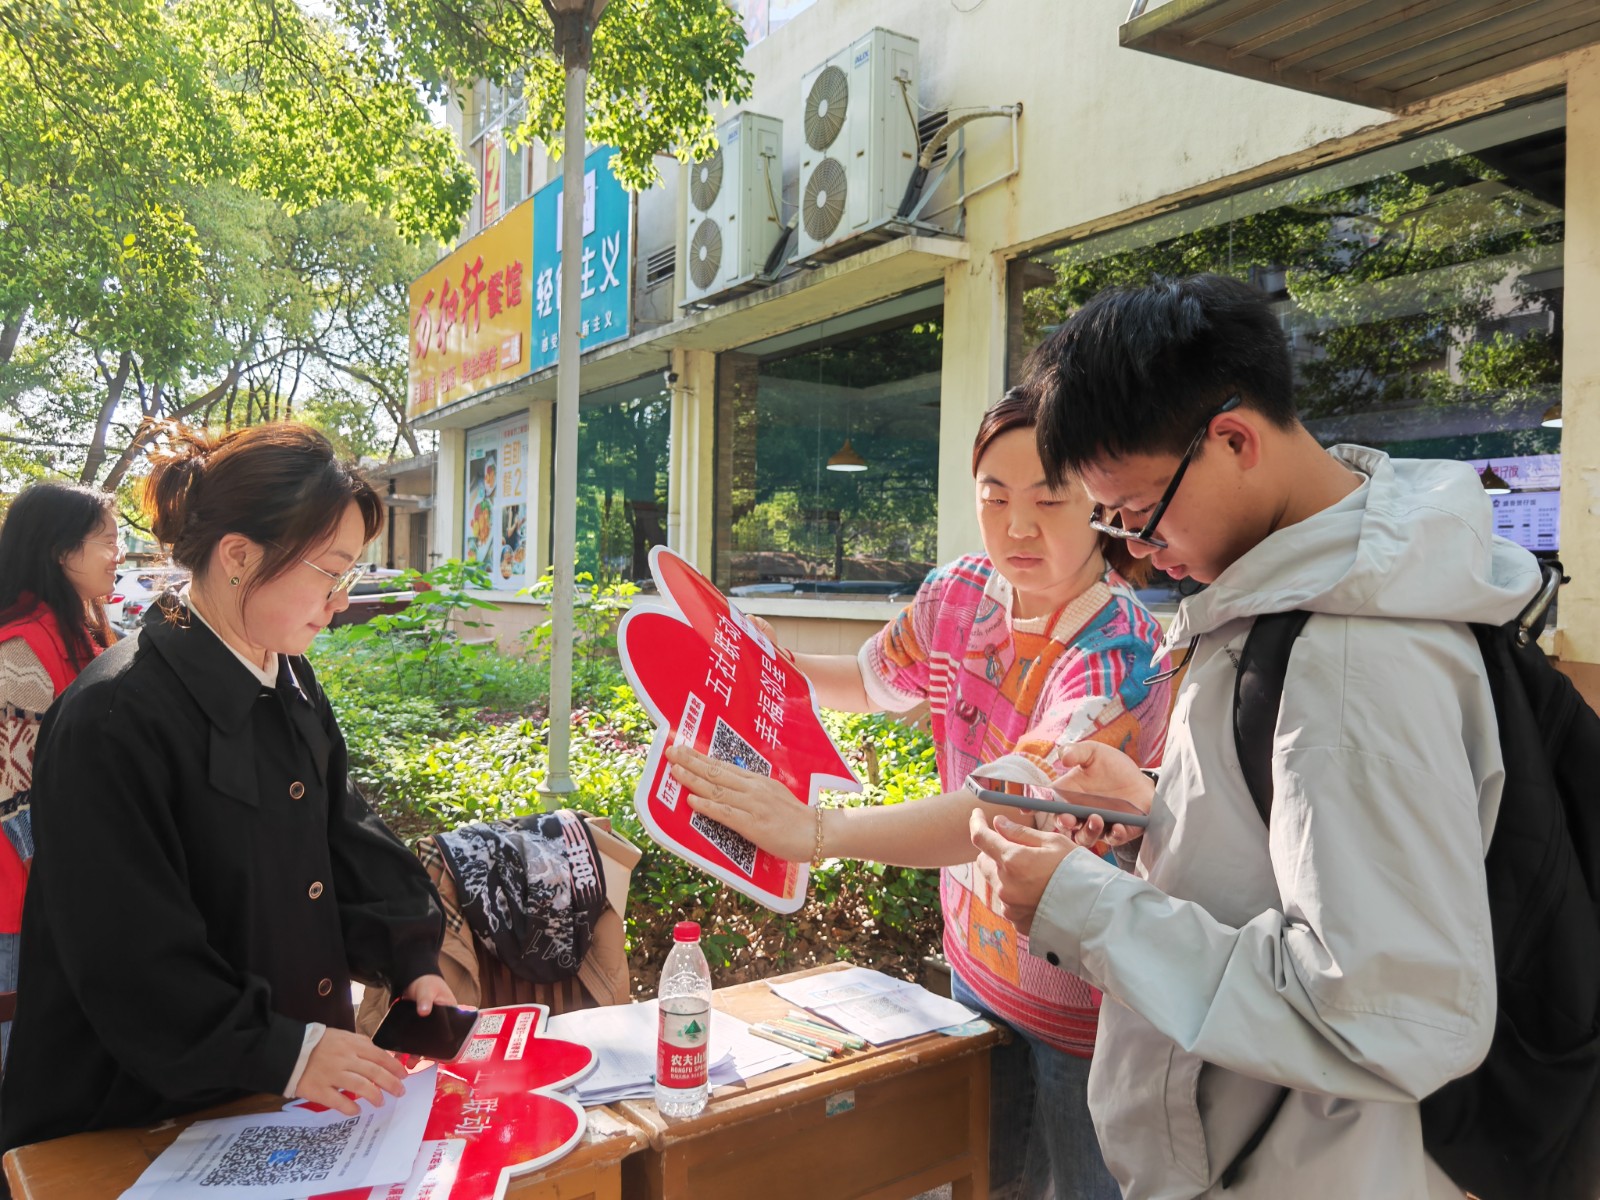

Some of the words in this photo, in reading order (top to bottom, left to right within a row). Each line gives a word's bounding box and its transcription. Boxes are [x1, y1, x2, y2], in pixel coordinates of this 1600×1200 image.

[705, 612, 742, 707] 五社联动
[671, 1052, 707, 1066] 农夫山
